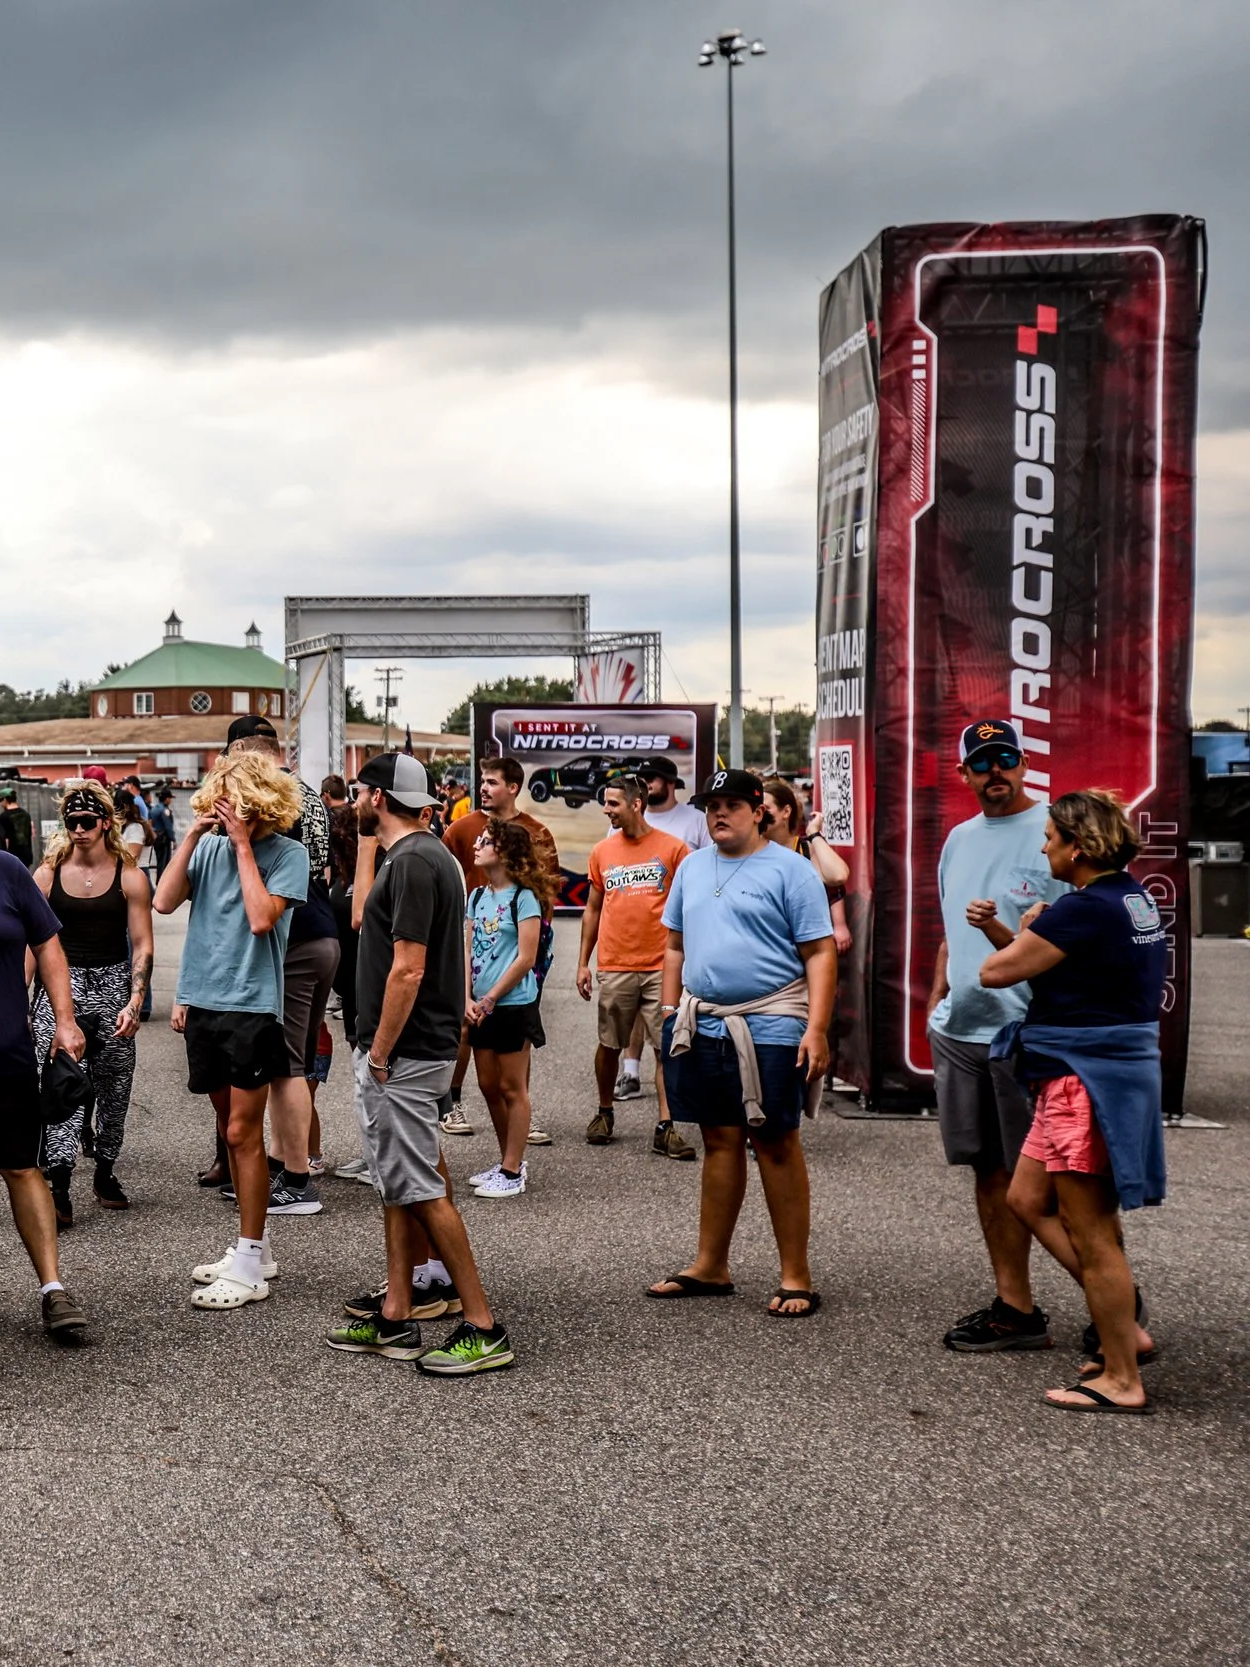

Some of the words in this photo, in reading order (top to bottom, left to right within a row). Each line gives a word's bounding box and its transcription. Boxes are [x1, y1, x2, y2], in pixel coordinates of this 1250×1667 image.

[528, 723, 560, 732] SENT
[565, 723, 576, 732] IT
[582, 723, 597, 732] AT
[513, 735, 670, 750] NITROCROSS
[712, 771, 728, 790] B
[606, 872, 659, 890] OUTLAWS
